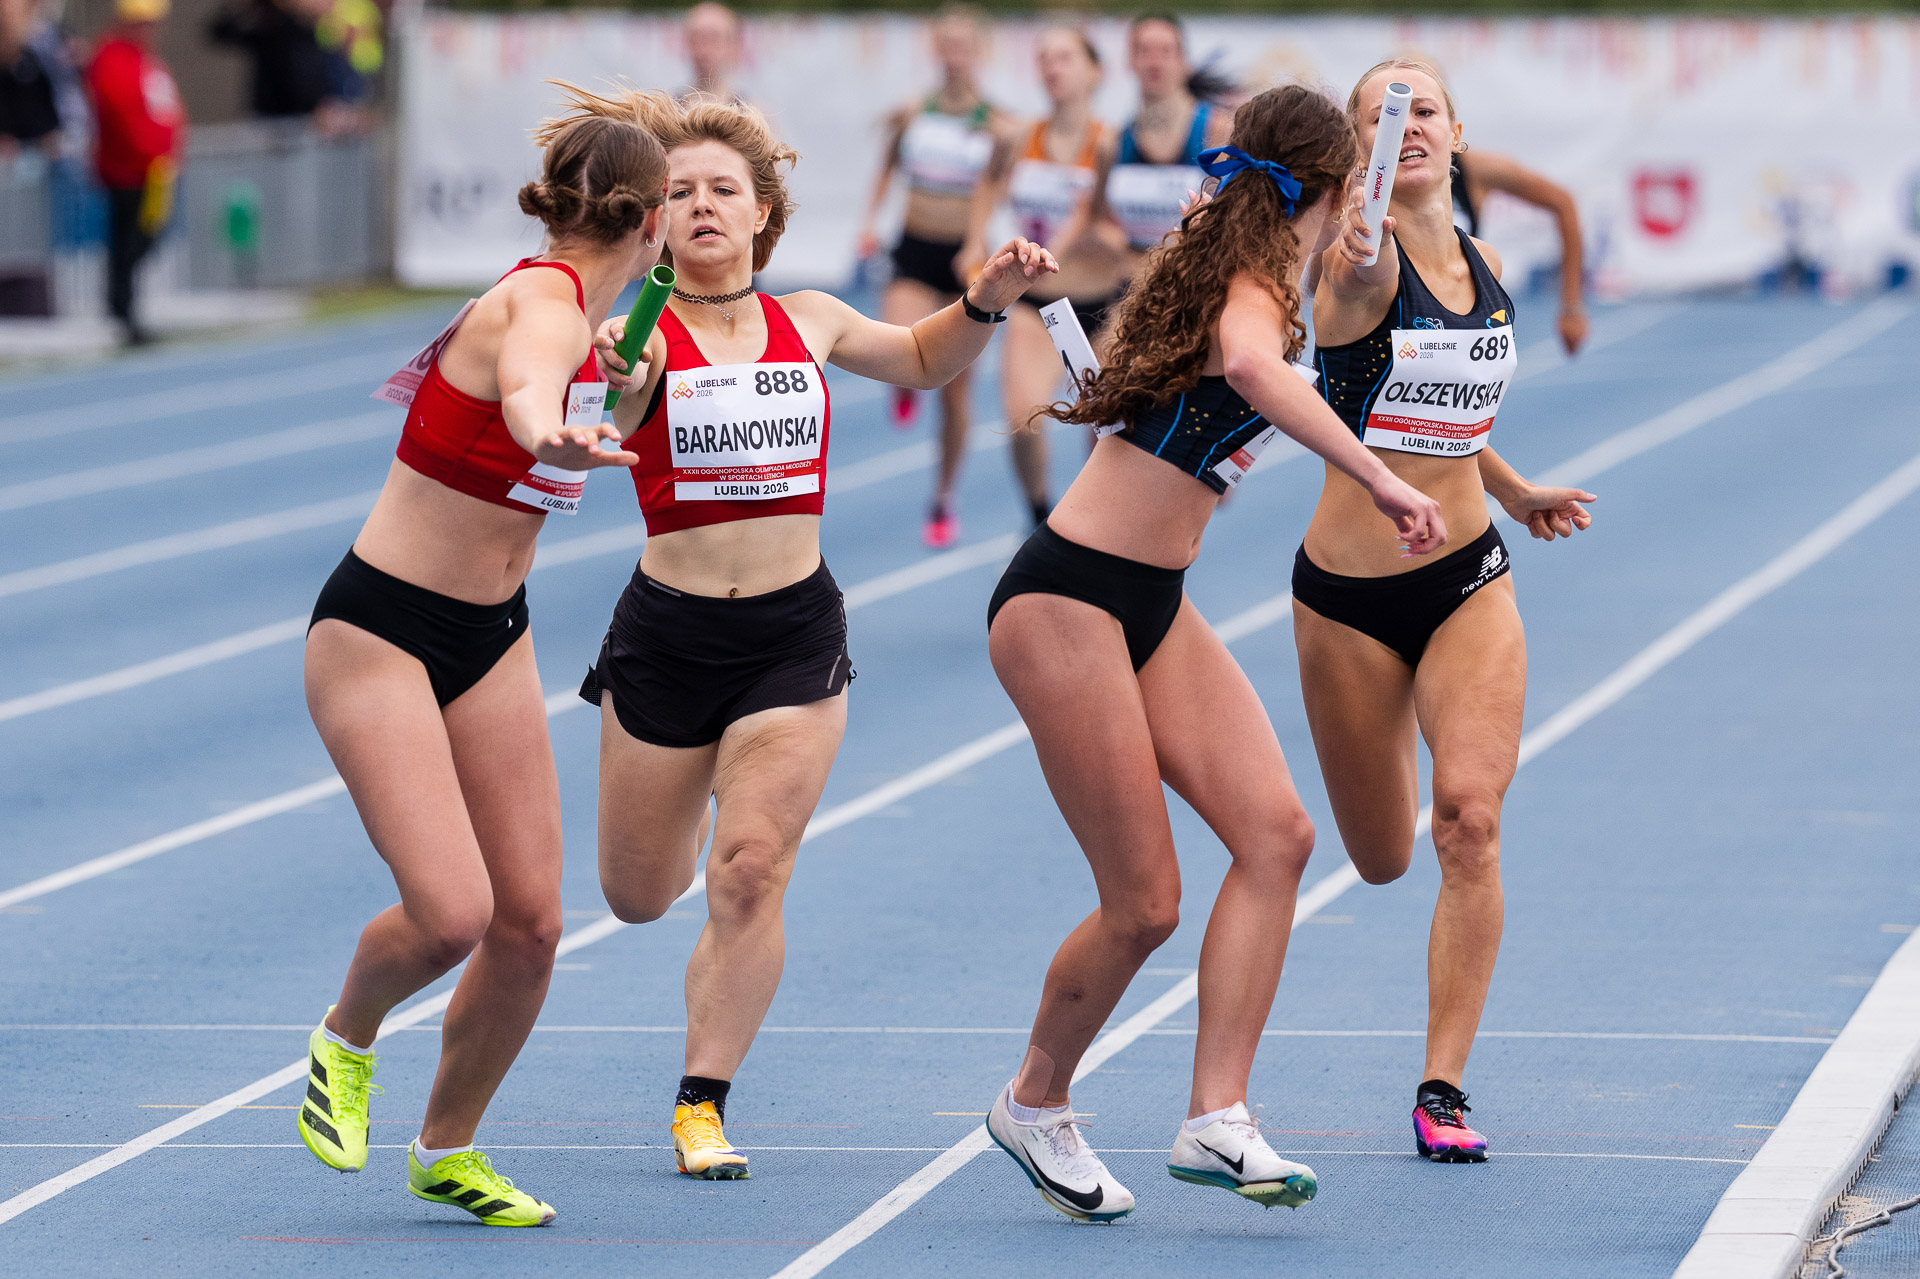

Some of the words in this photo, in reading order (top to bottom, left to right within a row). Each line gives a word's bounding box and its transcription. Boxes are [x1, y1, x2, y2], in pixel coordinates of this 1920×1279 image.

[1373, 171, 1383, 200] polanik
[1419, 342, 1458, 351] LUBELSKIE
[1469, 334, 1509, 362] 689
[1419, 351, 1434, 359] 2026
[695, 377, 738, 389] LUBELSKIE
[754, 369, 809, 396] 888
[696, 389, 713, 398] 2026
[1384, 380, 1504, 411] OLSZEWSKA
[1376, 415, 1394, 423] XXXII
[1393, 417, 1444, 430] OGÓLNOPOLSKA
[1444, 423, 1474, 431] OLIMPIADA
[674, 415, 817, 454] BARANOWSKA
[1417, 427, 1451, 437] SPORTACH
[1401, 436, 1445, 451] LUBLIN
[1446, 441, 1472, 452] 2026
[700, 467, 754, 475] OGÓLNOPOLSKA
[754, 464, 785, 474] OLIMPIADA
[727, 473, 763, 481] SPORTACH
[763, 471, 785, 480] LETNICH
[714, 485, 760, 496] LUBLIN
[763, 482, 789, 495] 2026
[541, 497, 576, 511] LUBLIN
[1461, 578, 1484, 595] new
